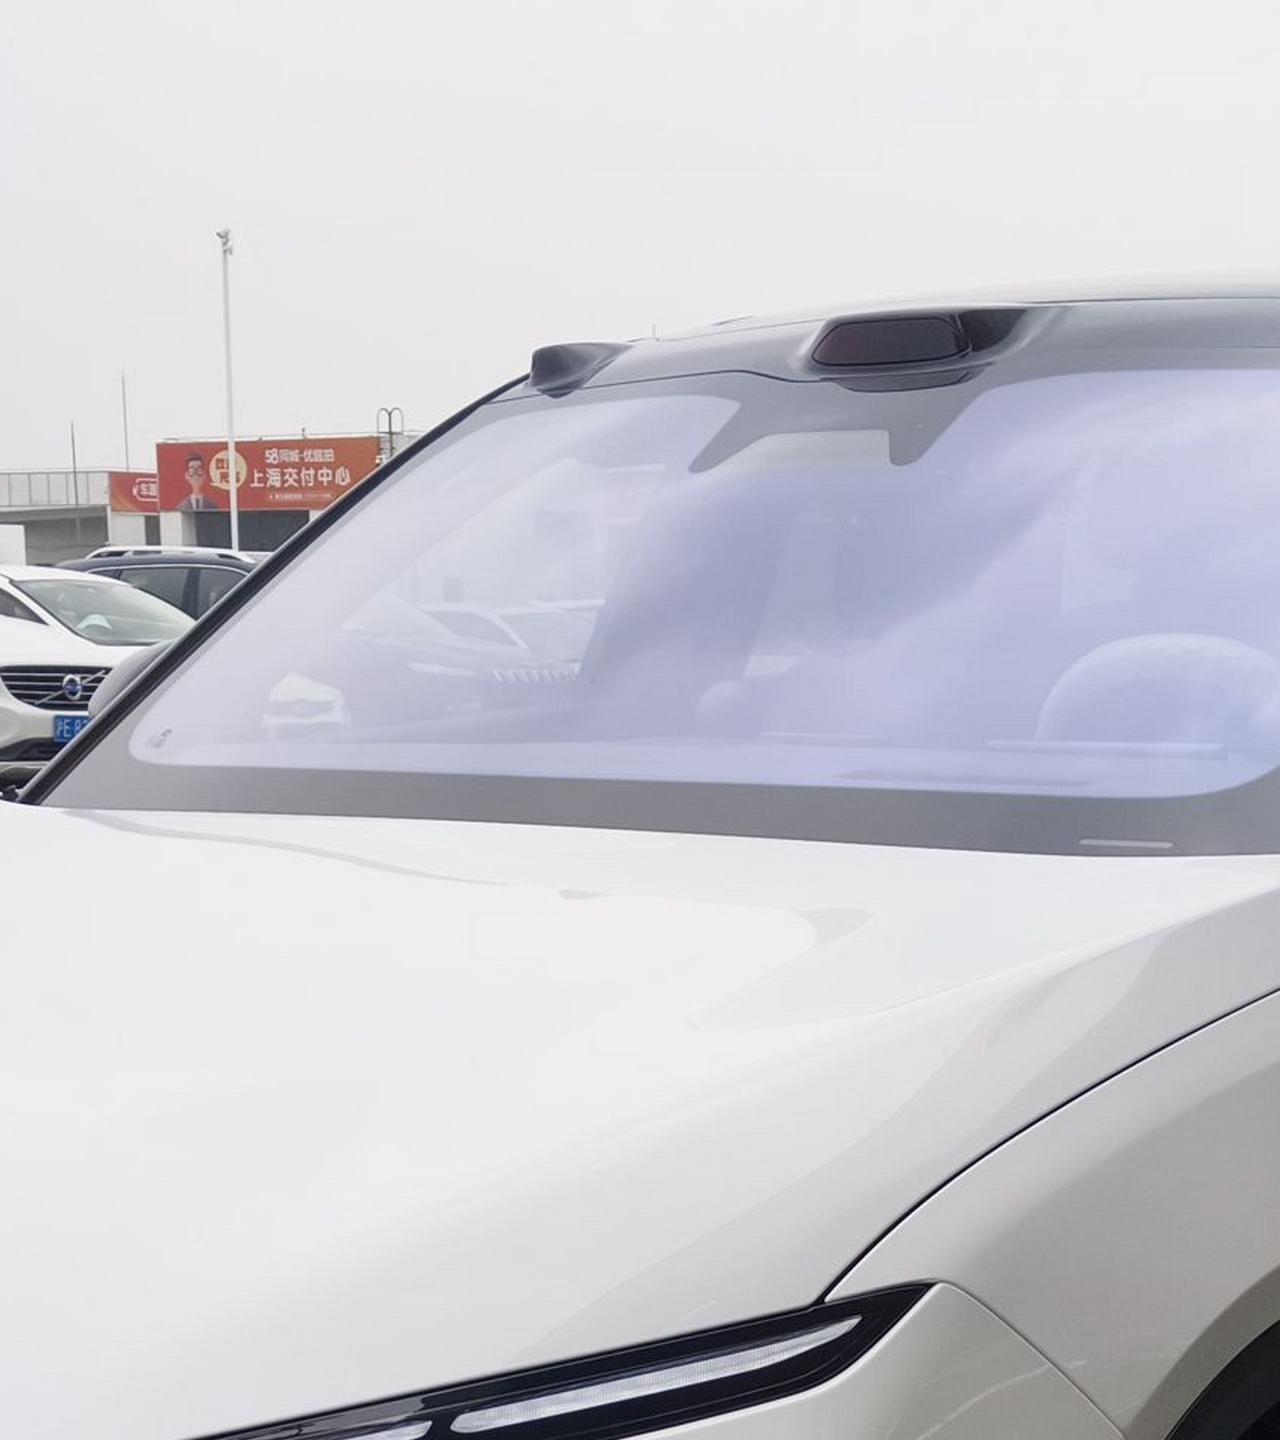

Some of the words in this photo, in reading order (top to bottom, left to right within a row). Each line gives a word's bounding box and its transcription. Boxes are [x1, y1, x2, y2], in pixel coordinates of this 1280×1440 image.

[250, 466, 352, 488] 上海交付中心
